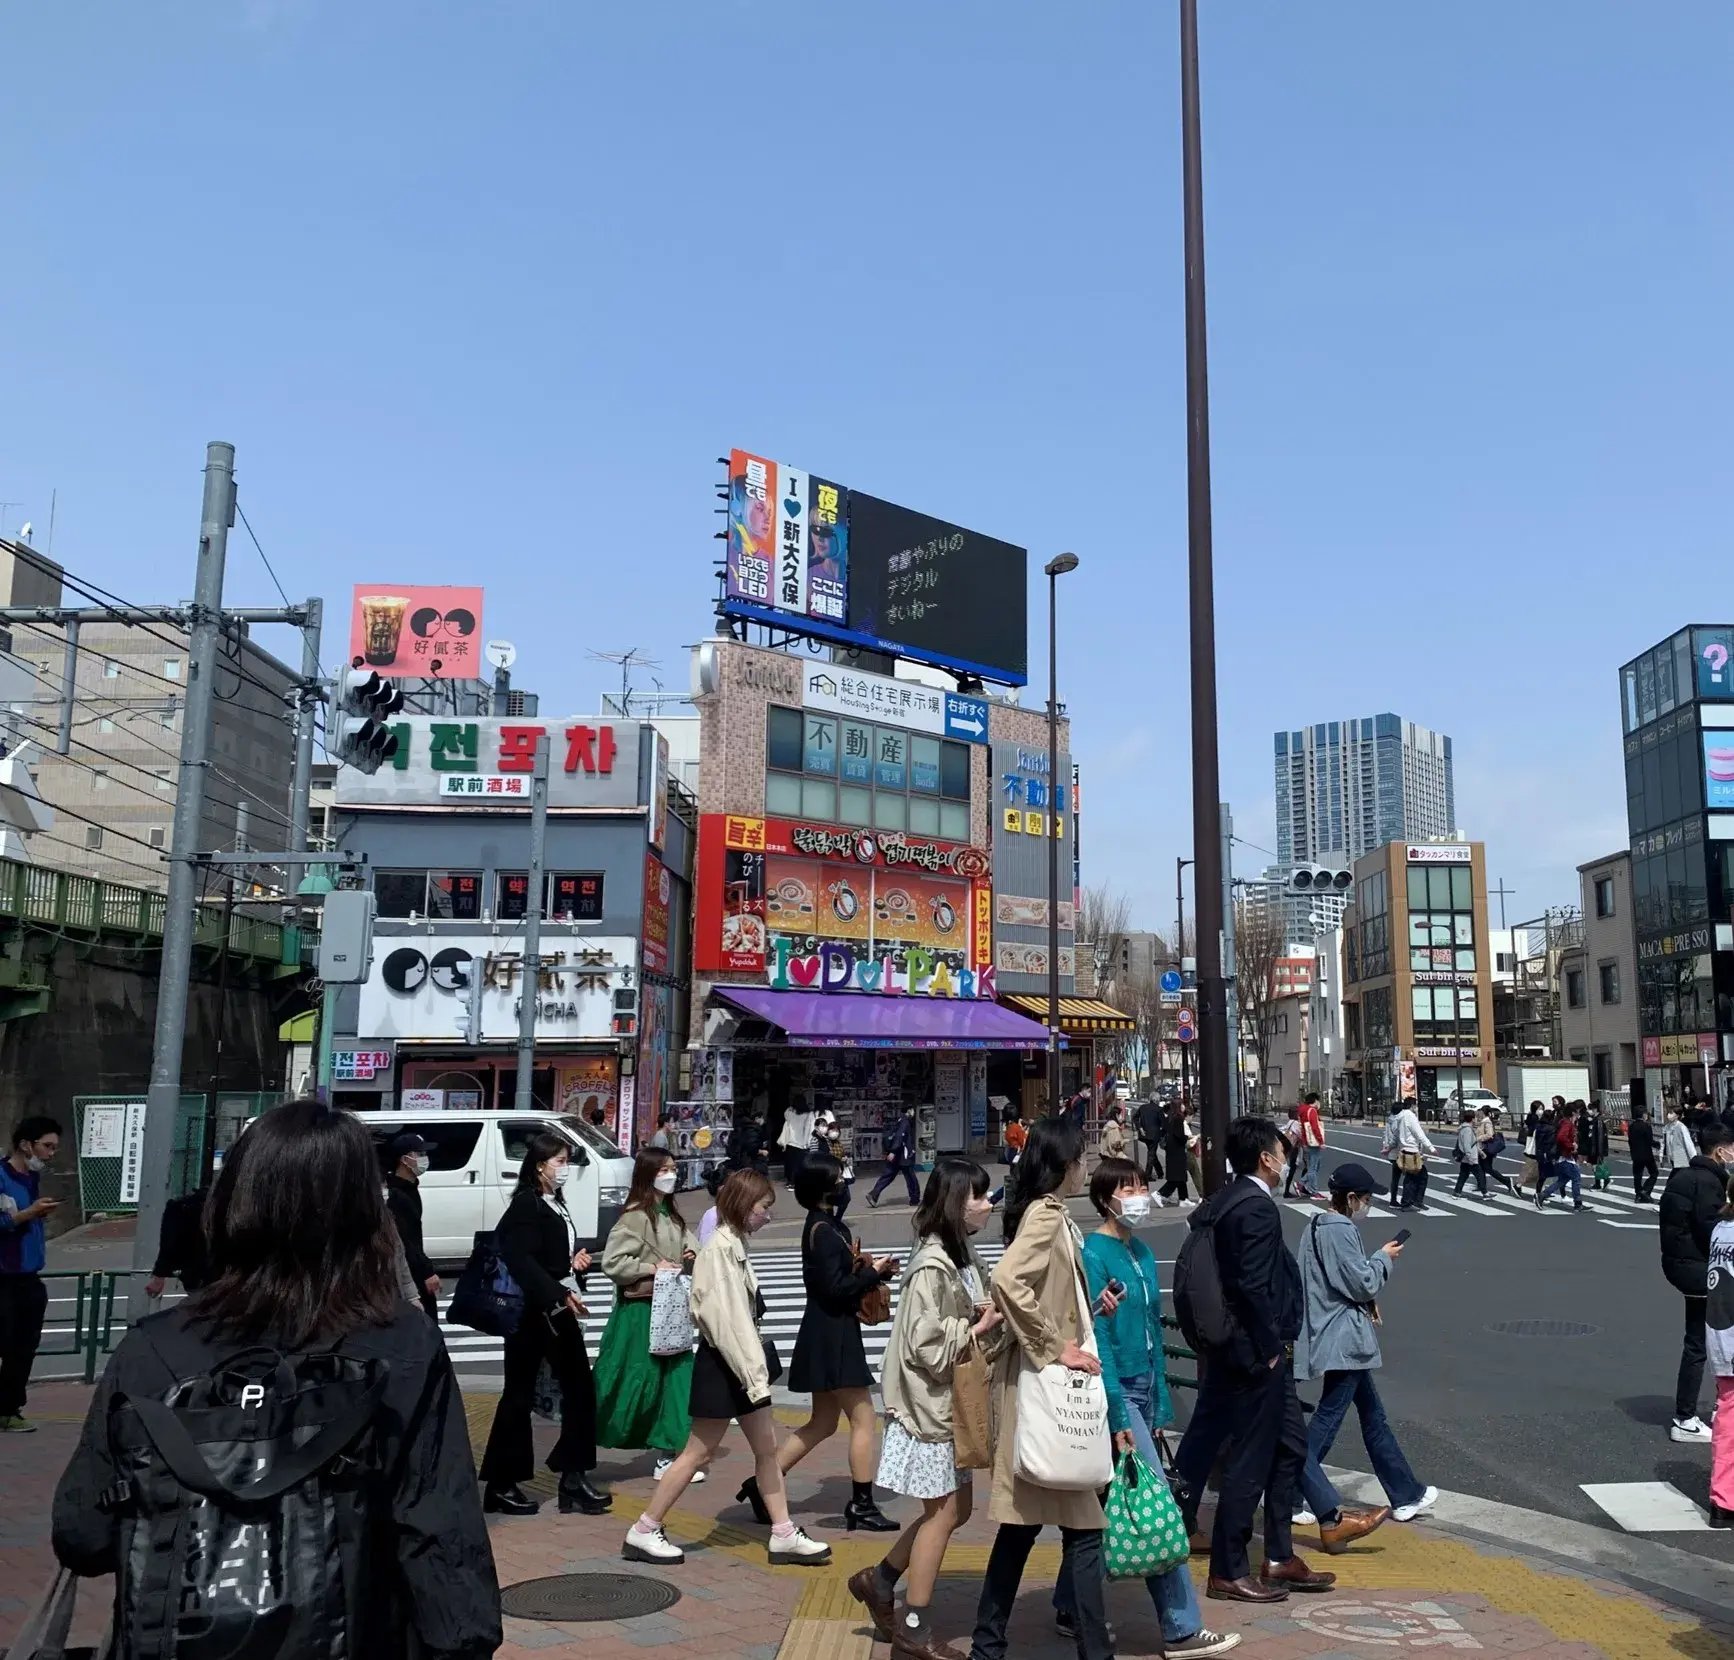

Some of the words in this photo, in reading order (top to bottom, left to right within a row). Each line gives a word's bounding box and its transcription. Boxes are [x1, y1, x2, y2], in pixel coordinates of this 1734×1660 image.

[789, 477, 797, 496] I
[738, 553, 769, 572] いつでも
[782, 520, 800, 605] 新大久保
[738, 567, 769, 583] 目立つ
[888, 568, 938, 598] デジタル
[738, 577, 768, 599] LED
[811, 577, 844, 595] ここに
[878, 641, 905, 653] NAGATA
[841, 676, 940, 714] 総合住宅展示場
[948, 698, 985, 719] 右折すぐ
[809, 720, 902, 765] 不動産
[448, 778, 522, 793] 駅前酒場
[1713, 786, 1734, 795] ミル
[742, 852, 753, 912] のびーる
[978, 892, 989, 961] トッポッキ
[1640, 940, 1663, 958] MACA
[902, 948, 998, 1000] PARK
[336, 1069, 373, 1077] 駅前酒場
[565, 1080, 617, 1096] CROFFLE
[131, 1108, 139, 1138] 新大久保駅
[127, 1142, 137, 1198] 自転車等駐輪場
[1055, 1407, 1100, 1420] NYANDER
[1057, 1424, 1099, 1437] WOMAN!
